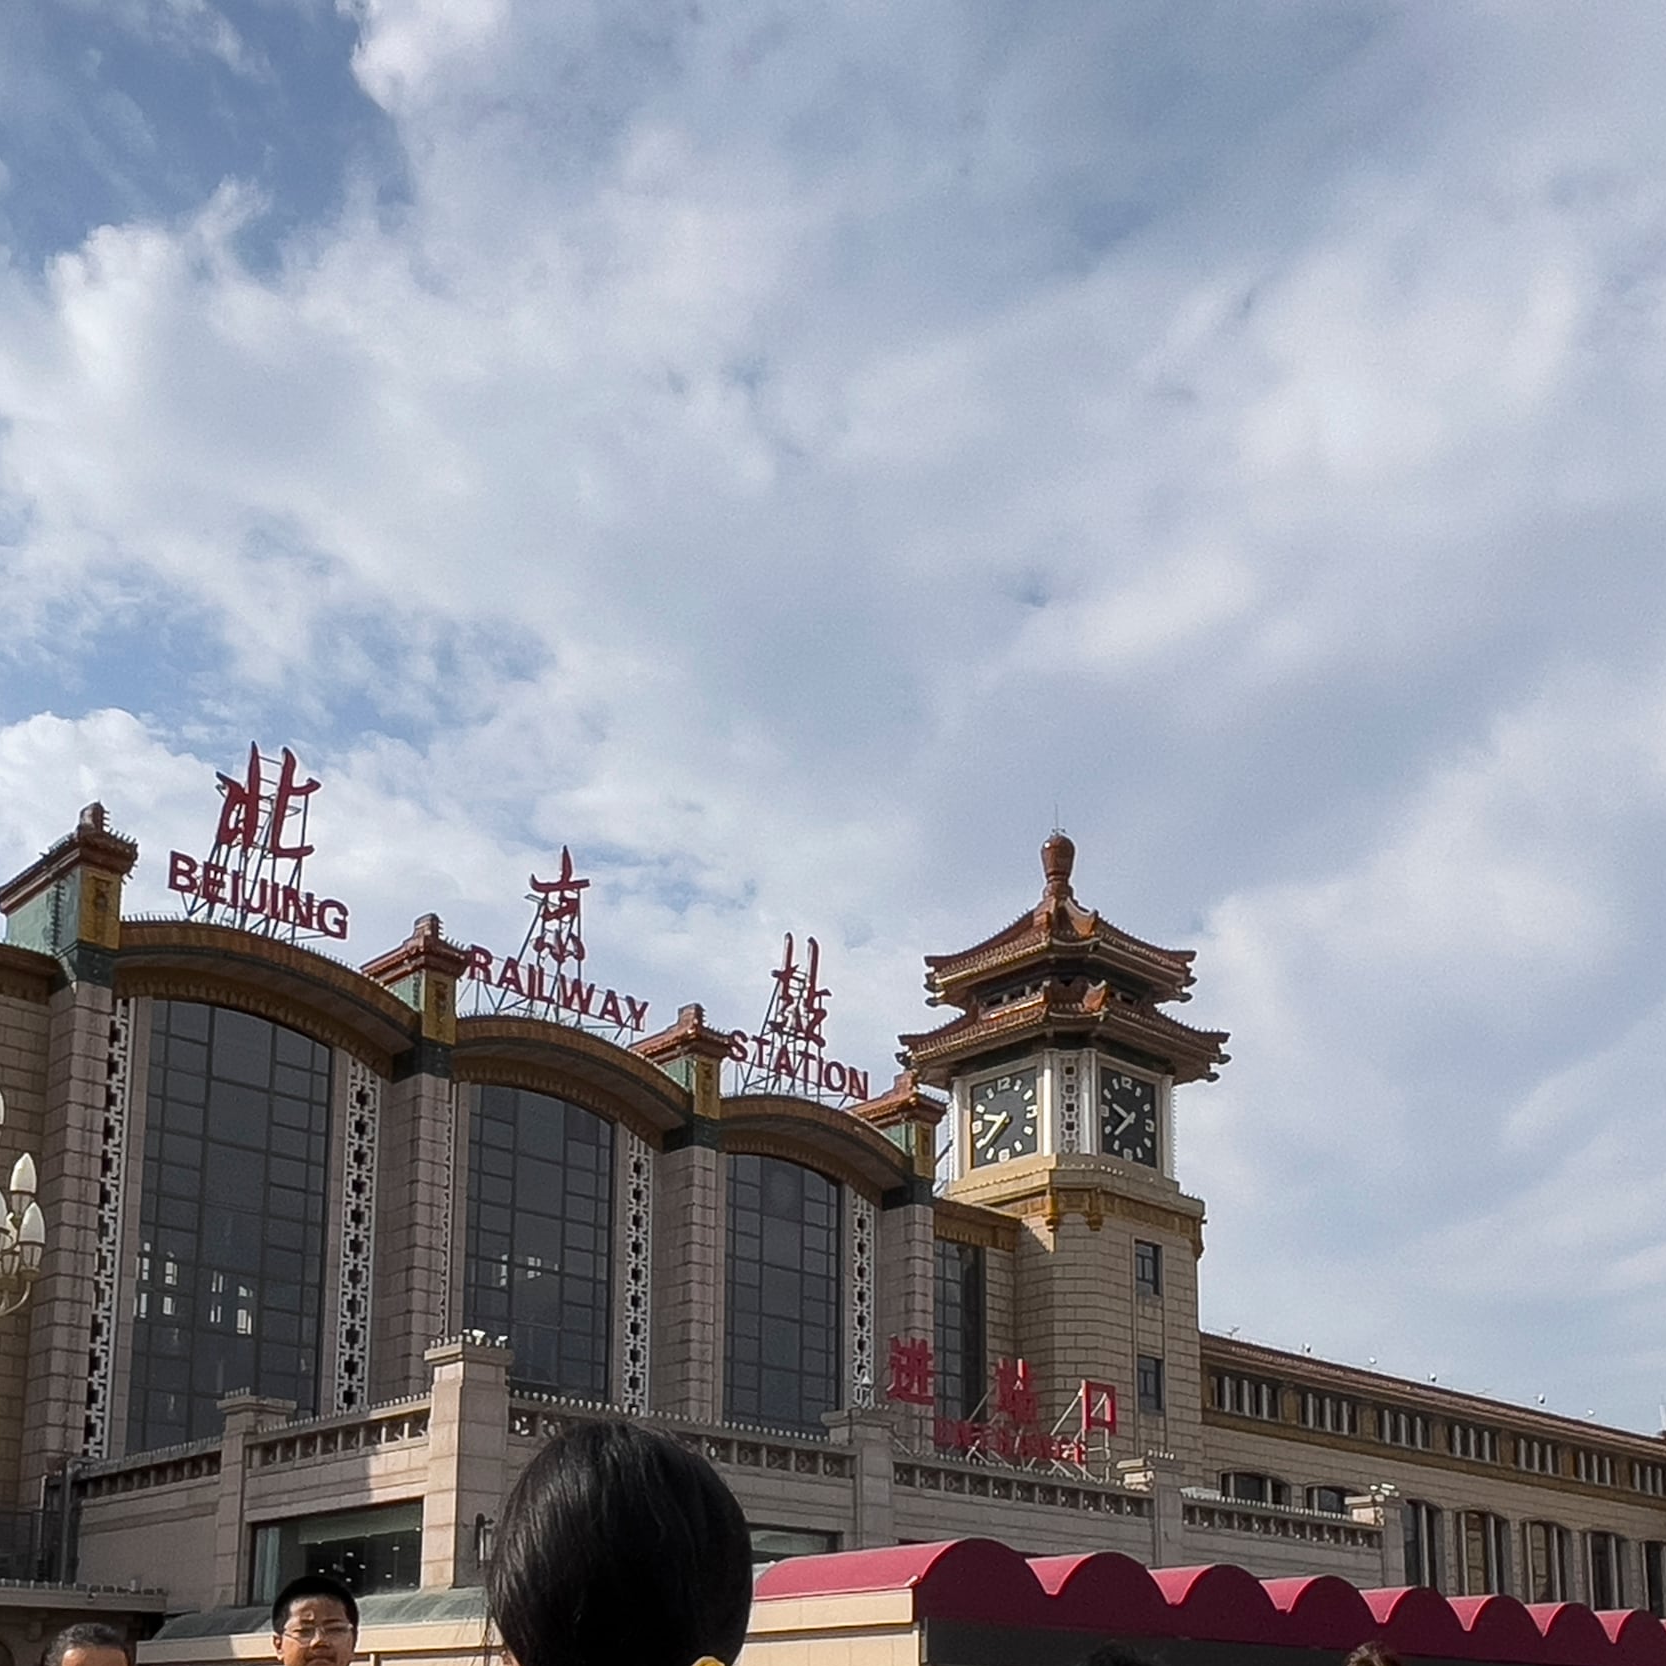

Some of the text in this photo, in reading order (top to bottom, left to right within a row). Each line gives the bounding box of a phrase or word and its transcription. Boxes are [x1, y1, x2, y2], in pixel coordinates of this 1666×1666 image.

[168, 850, 868, 1101] BEIJING RAILWAY STATION
[997, 1076, 1011, 1092] 12
